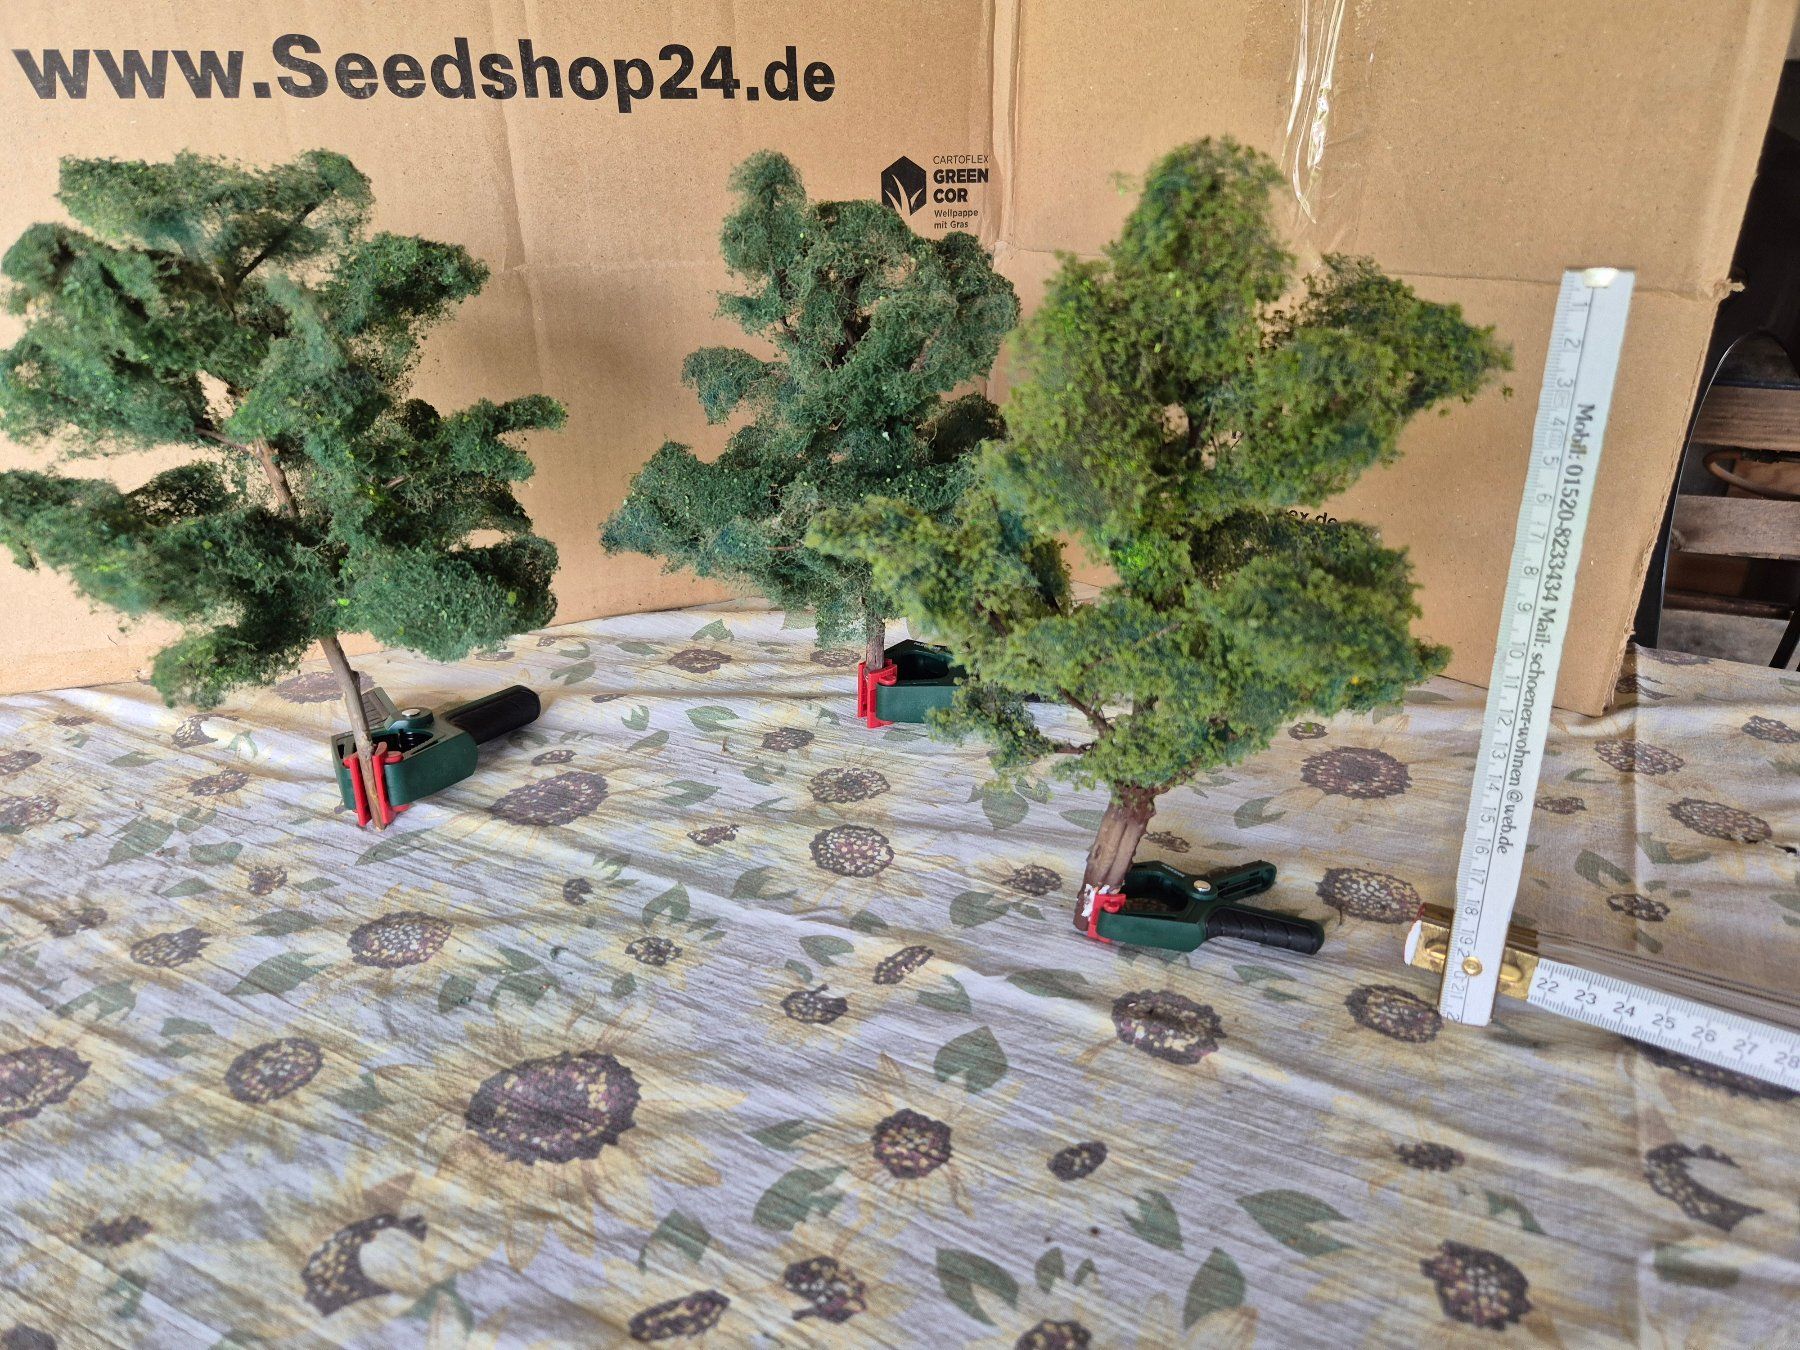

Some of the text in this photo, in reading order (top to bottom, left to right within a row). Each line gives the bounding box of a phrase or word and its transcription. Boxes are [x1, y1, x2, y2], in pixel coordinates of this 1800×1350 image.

[12, 33, 836, 114] www.Seedshop24.de
[933, 155, 989, 165] CARTOFLEX
[933, 168, 989, 184] GREEN
[933, 188, 968, 203] COR
[934, 209, 979, 219] Wellpappe
[934, 220, 969, 229] mit Gras
[1564, 338, 1581, 348] 2
[1557, 379, 1574, 388] 3
[1553, 417, 1566, 427] 4
[1568, 403, 1596, 460] Mobil:
[1543, 455, 1560, 466] 5
[1536, 493, 1553, 504] 6
[1541, 464, 1584, 602] 01520-8233434
[1523, 565, 1539, 576] 8
[1517, 602, 1533, 613] 9
[1533, 606, 1557, 648] Mail:
[1509, 642, 1526, 659] 10
[1504, 675, 1520, 689] 11
[1498, 709, 1514, 726] 12
[1492, 742, 1508, 760] 13
[1487, 774, 1503, 791] 14
[1481, 806, 1497, 824] 15
[1475, 837, 1492, 855] 16
[1470, 868, 1486, 885] 17
[1465, 899, 1480, 916] 18
[1459, 929, 1475, 945] 19
[1536, 977, 1800, 1069] 22 23 24 25 26 27 28
